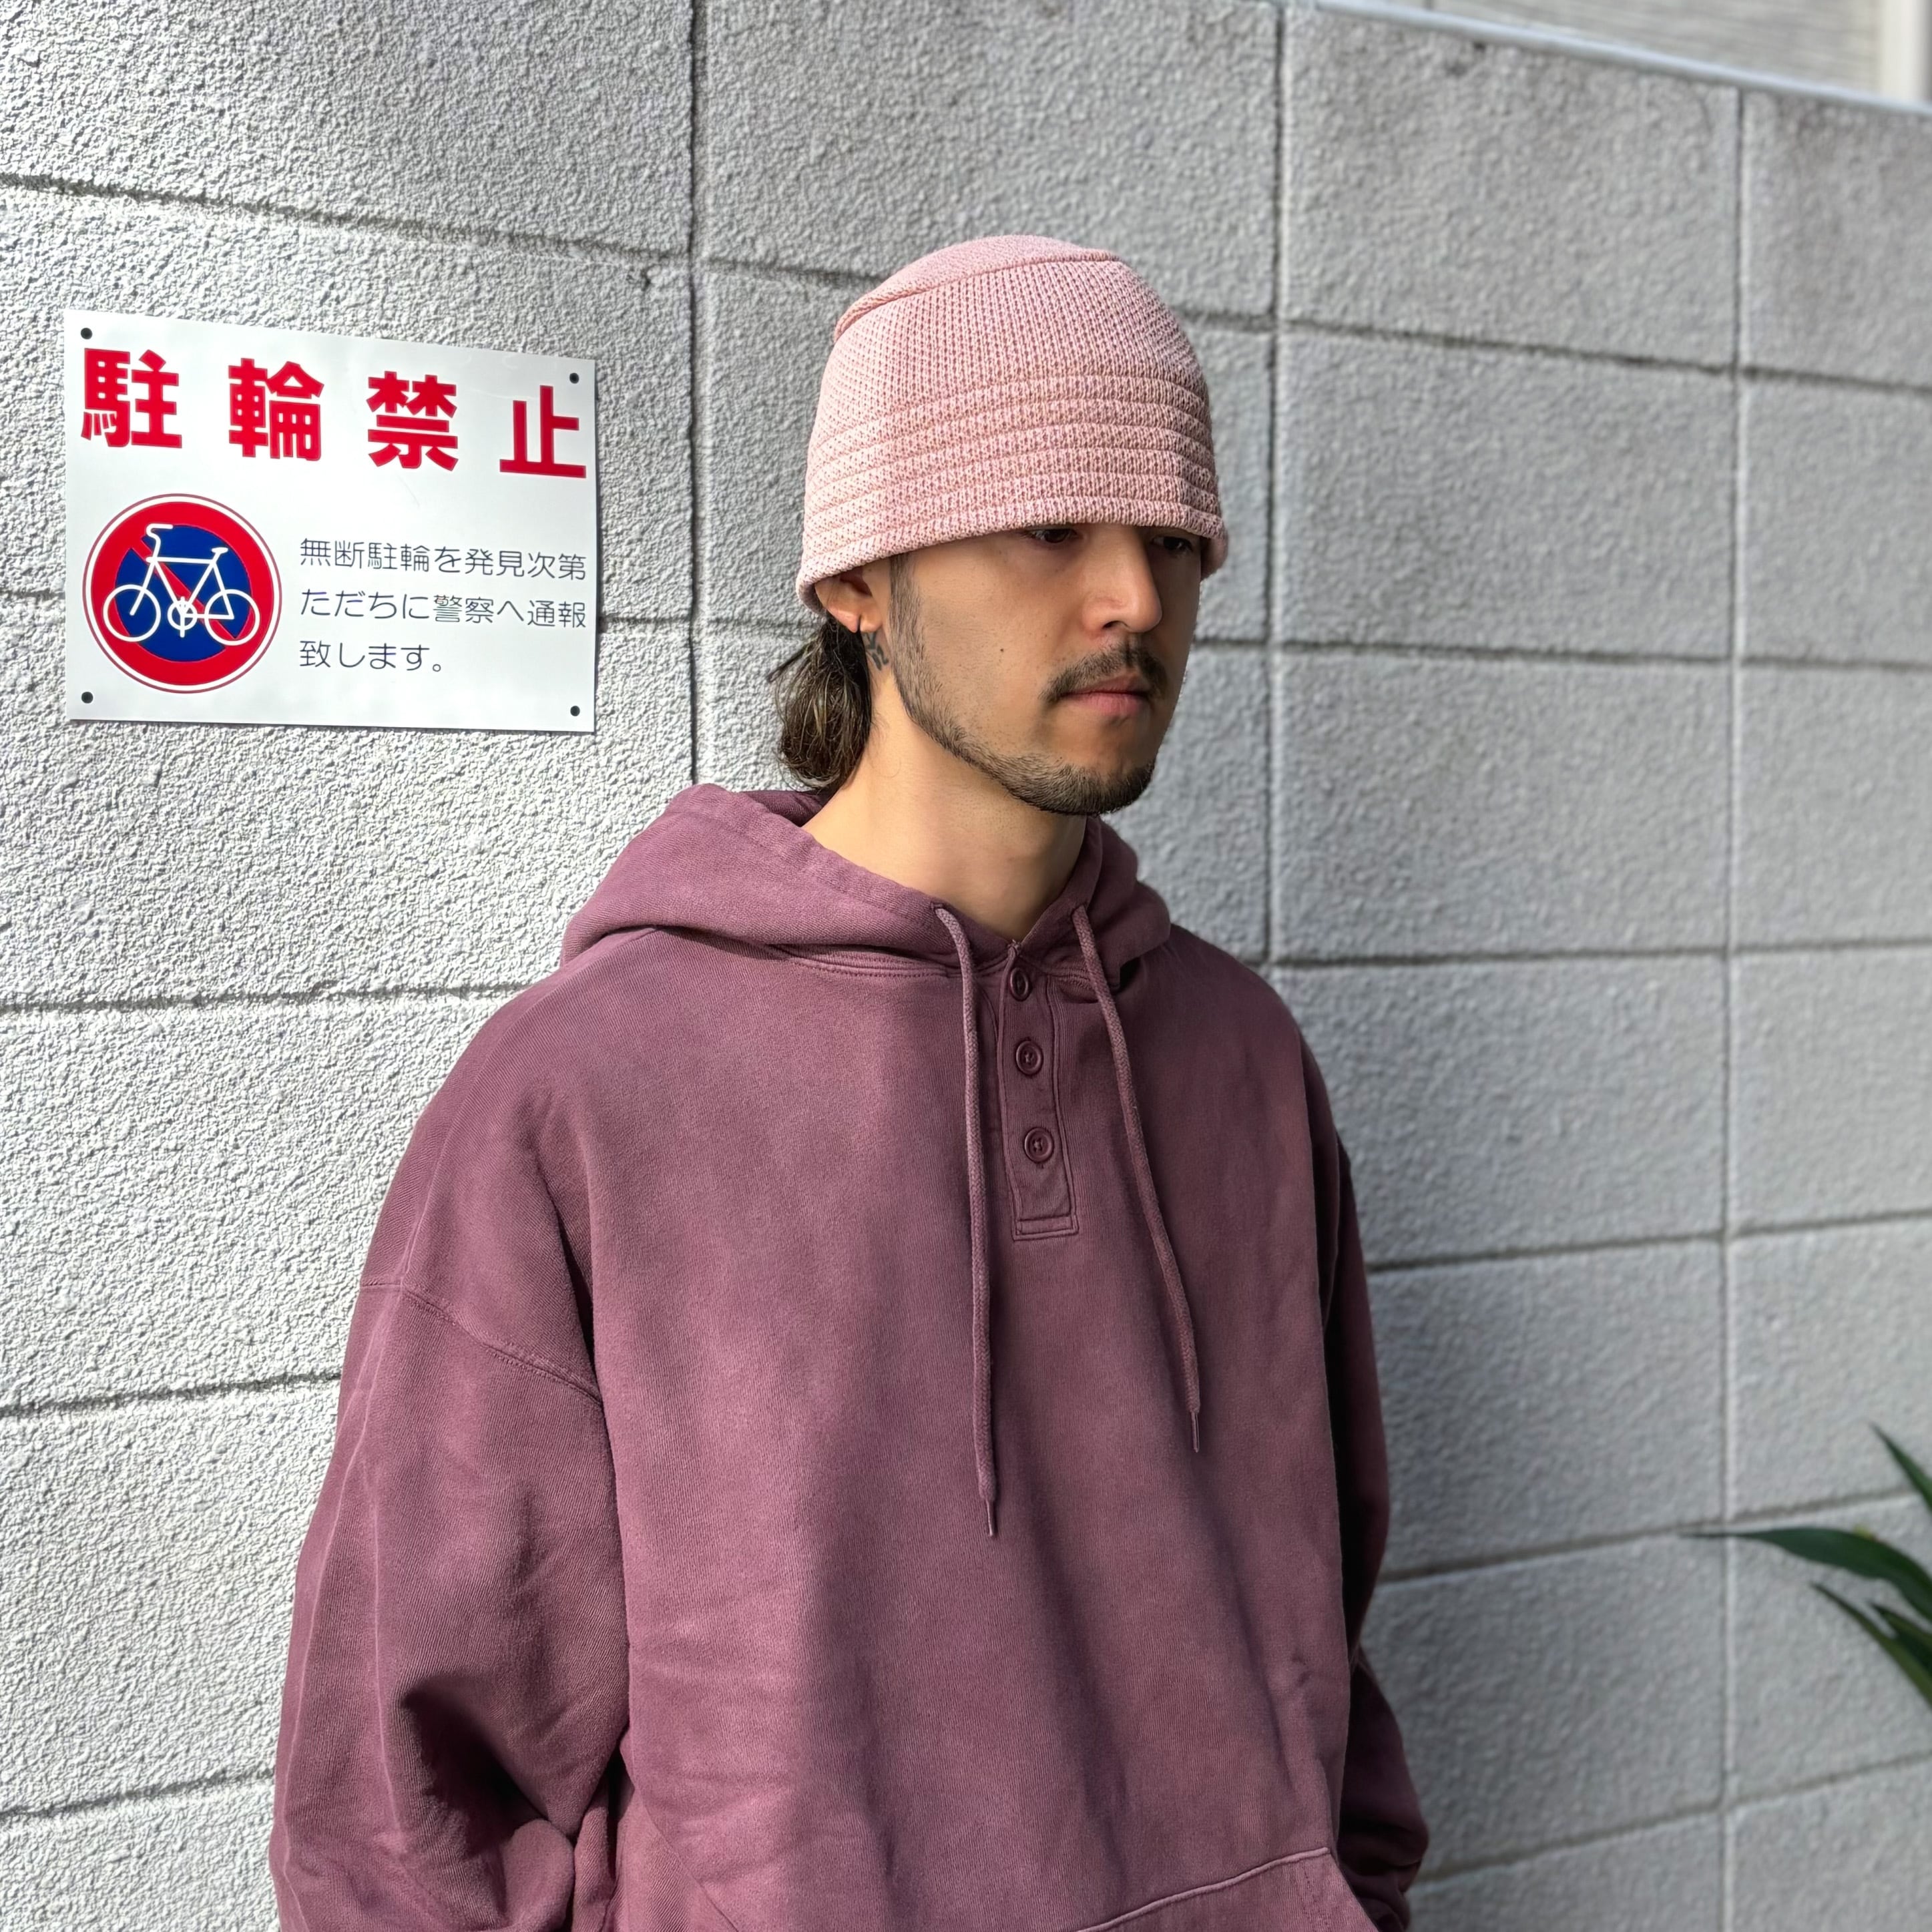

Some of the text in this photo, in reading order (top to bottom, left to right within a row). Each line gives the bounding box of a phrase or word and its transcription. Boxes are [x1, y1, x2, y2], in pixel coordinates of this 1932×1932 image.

[80, 347, 587, 479] 駐輪禁止
[299, 537, 587, 581] 無断駐輪を発見次第
[299, 589, 587, 629] ただちに警察へ通報
[299, 640, 443, 673] 致します。
